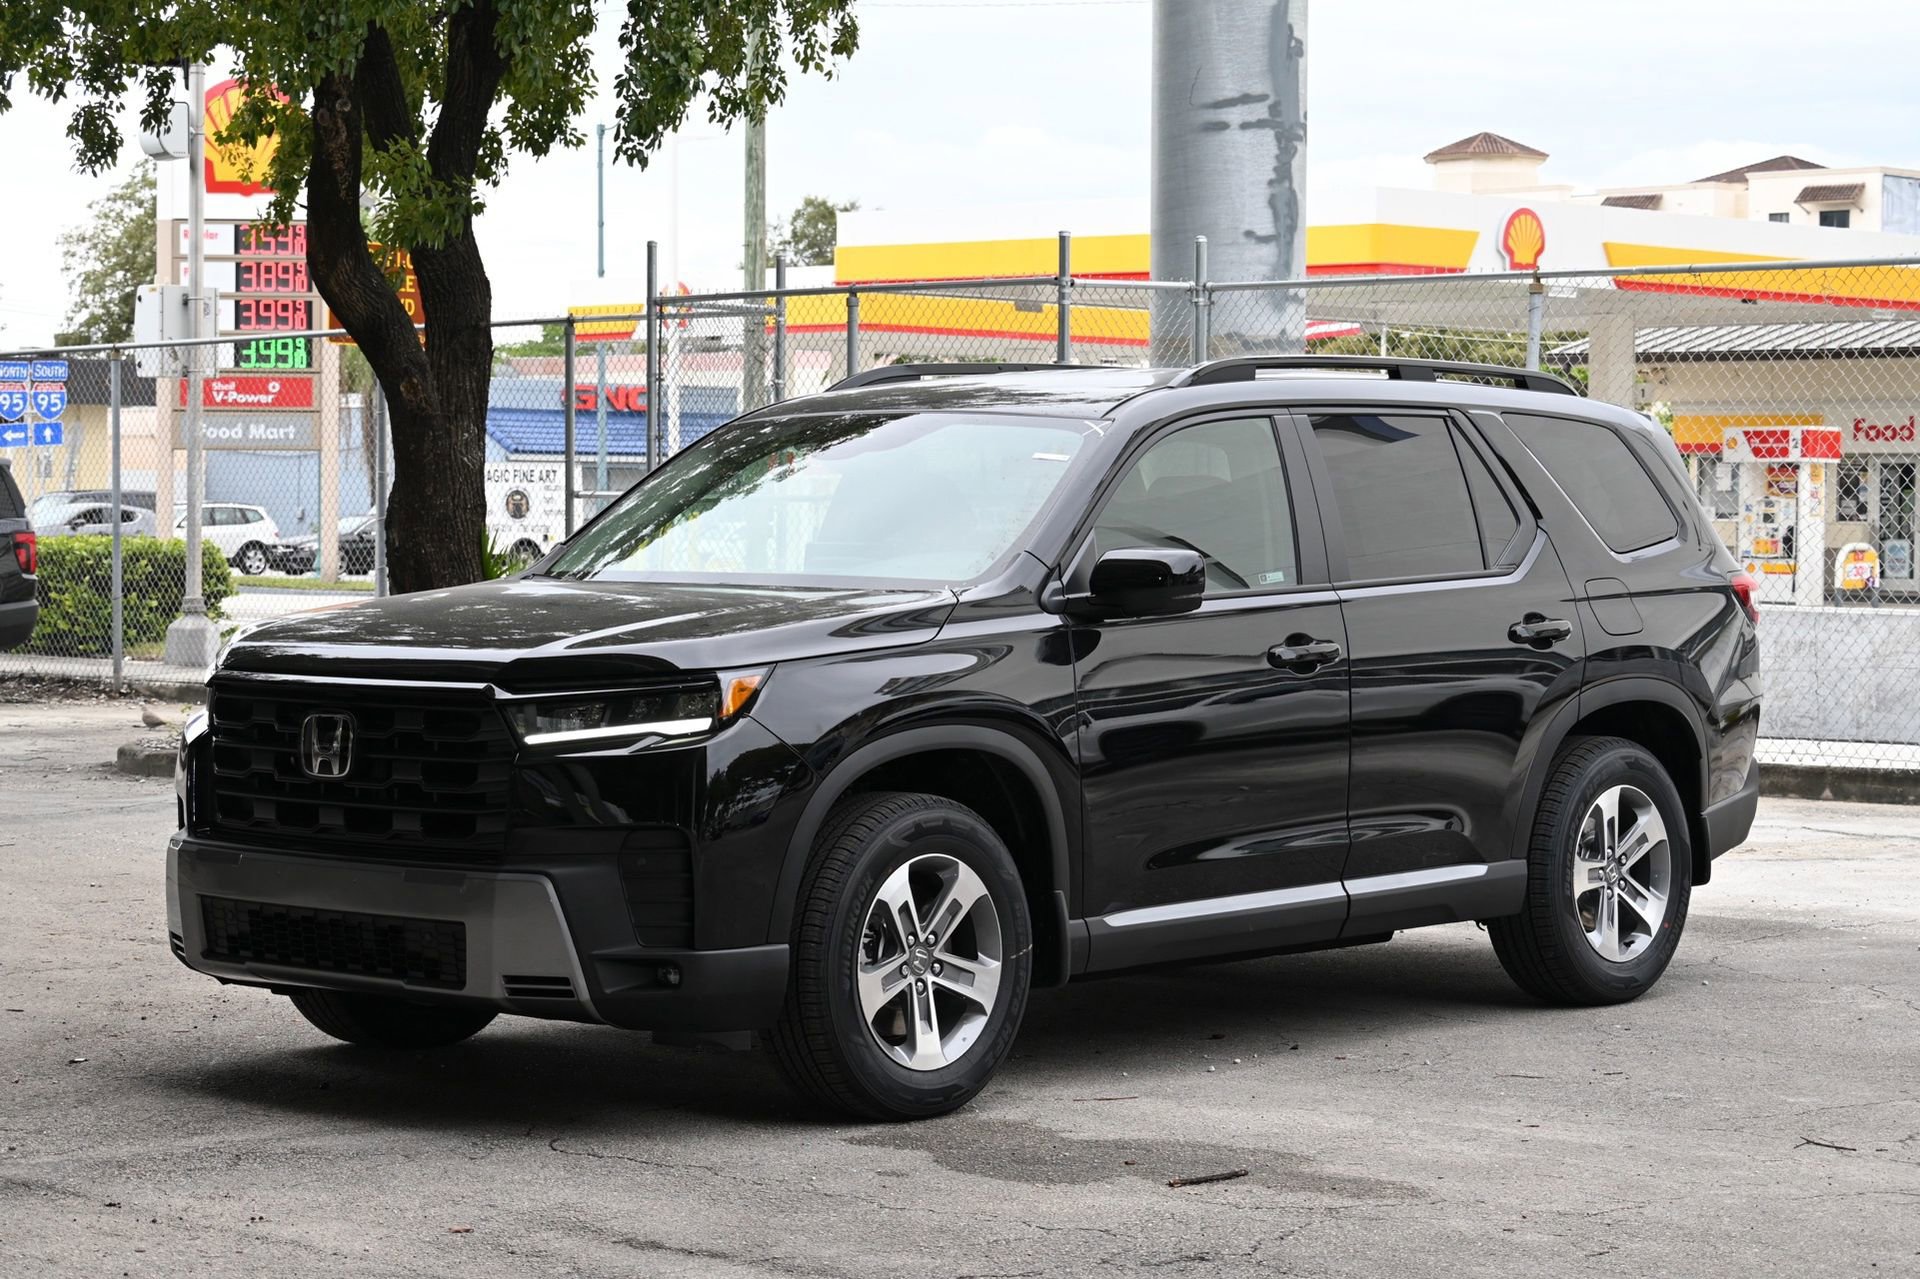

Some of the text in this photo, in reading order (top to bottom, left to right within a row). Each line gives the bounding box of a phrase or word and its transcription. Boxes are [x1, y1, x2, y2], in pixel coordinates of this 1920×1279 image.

[240, 262, 294, 292] 3.89
[240, 300, 293, 330] 3.99
[34, 364, 66, 377] SOUTH
[212, 382, 236, 391] Shell
[0, 393, 24, 412] 95
[37, 393, 62, 412] 95
[212, 391, 275, 403] V-Power
[561, 384, 648, 411] GNC
[249, 424, 296, 440] Mart
[487, 469, 558, 483] AGIC FINE ART
